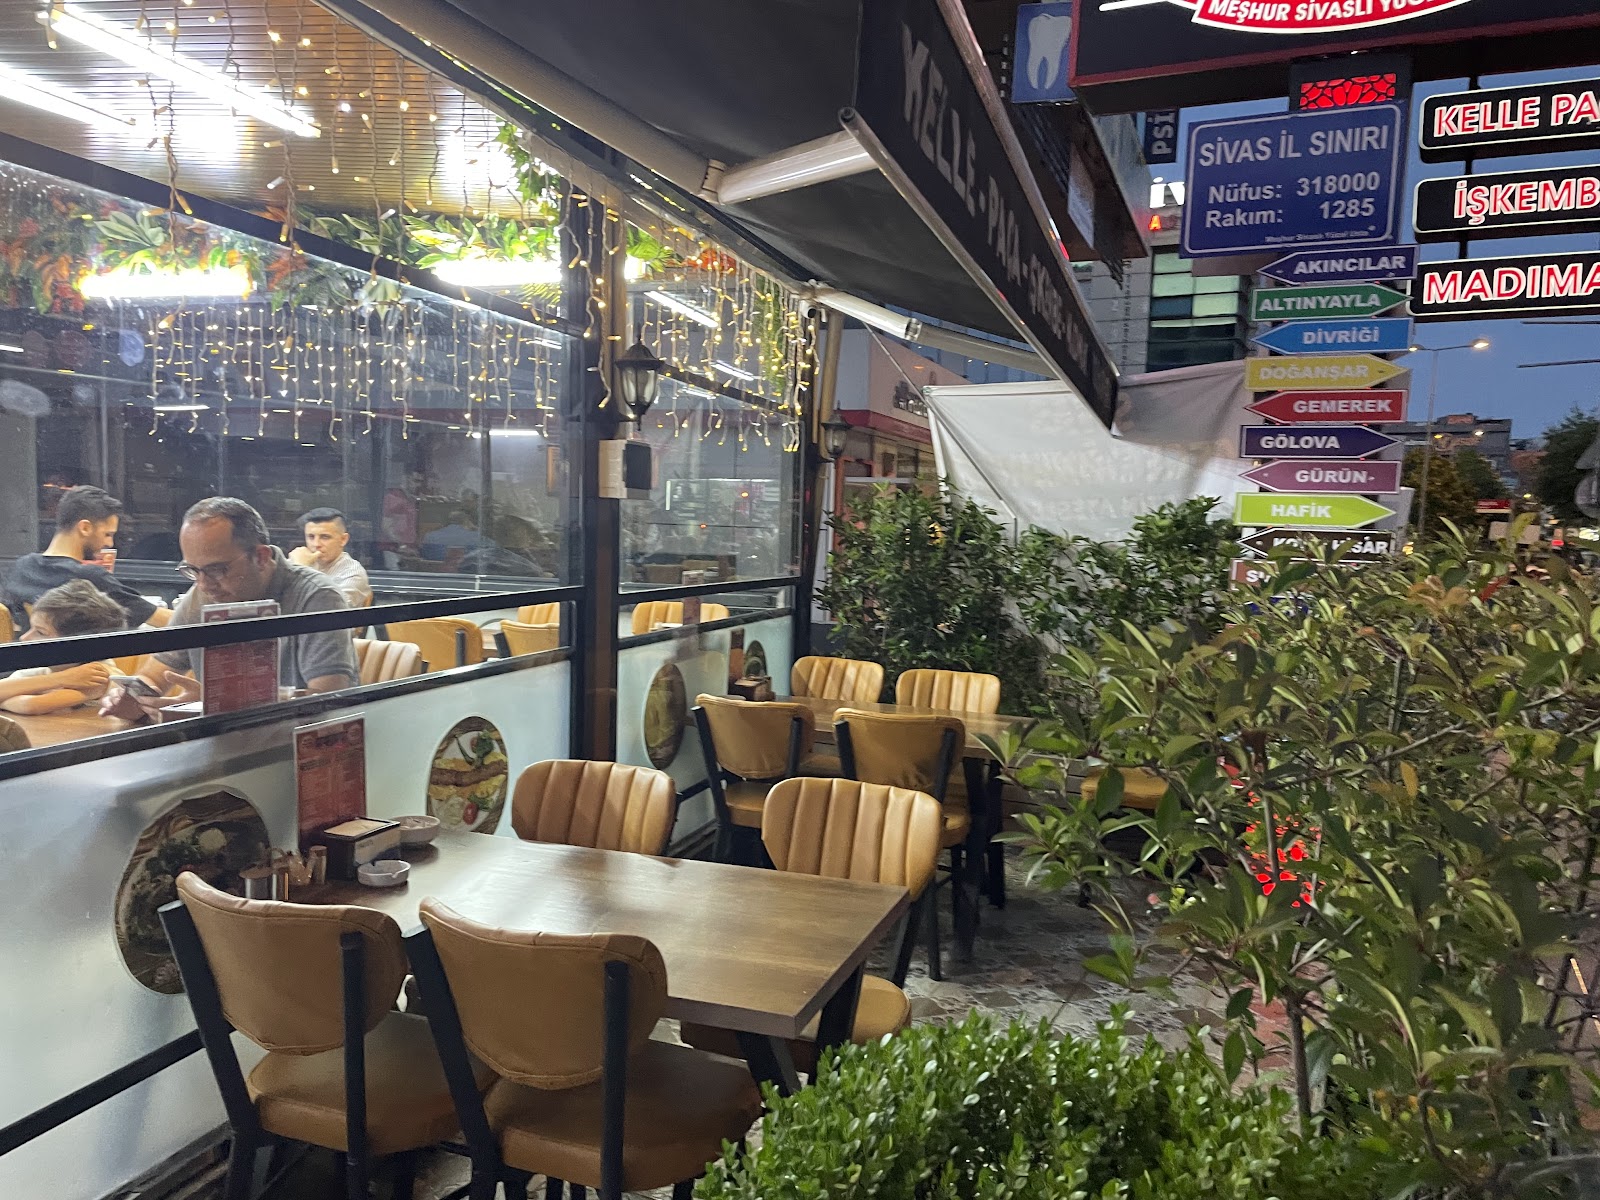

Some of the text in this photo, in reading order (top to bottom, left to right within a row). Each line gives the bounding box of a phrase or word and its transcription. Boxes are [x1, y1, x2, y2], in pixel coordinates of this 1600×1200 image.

[1207, 1, 1290, 23] MEŞHUR
[1294, 0, 1374, 20] SİVASLI
[1433, 90, 1600, 138] KELLE PA
[1199, 125, 1389, 167] SİVAS İL SINIRI
[1208, 171, 1381, 204] Nüfus: 318000
[1453, 176, 1600, 226] İŞKEMB
[1205, 197, 1376, 228] Rakım: 1285
[1293, 255, 1407, 275] AKINCILAR
[1259, 293, 1382, 312] ALTINYAYLA
[1303, 327, 1380, 345] DİVRİĞİ
[1260, 363, 1369, 380] DOĞANŞAR
[1292, 399, 1392, 413] GEMEREK
[1259, 433, 1341, 449] GÖLOVA
[1295, 467, 1368, 483] GÜRÜN
[1270, 502, 1332, 518] HAFİK
